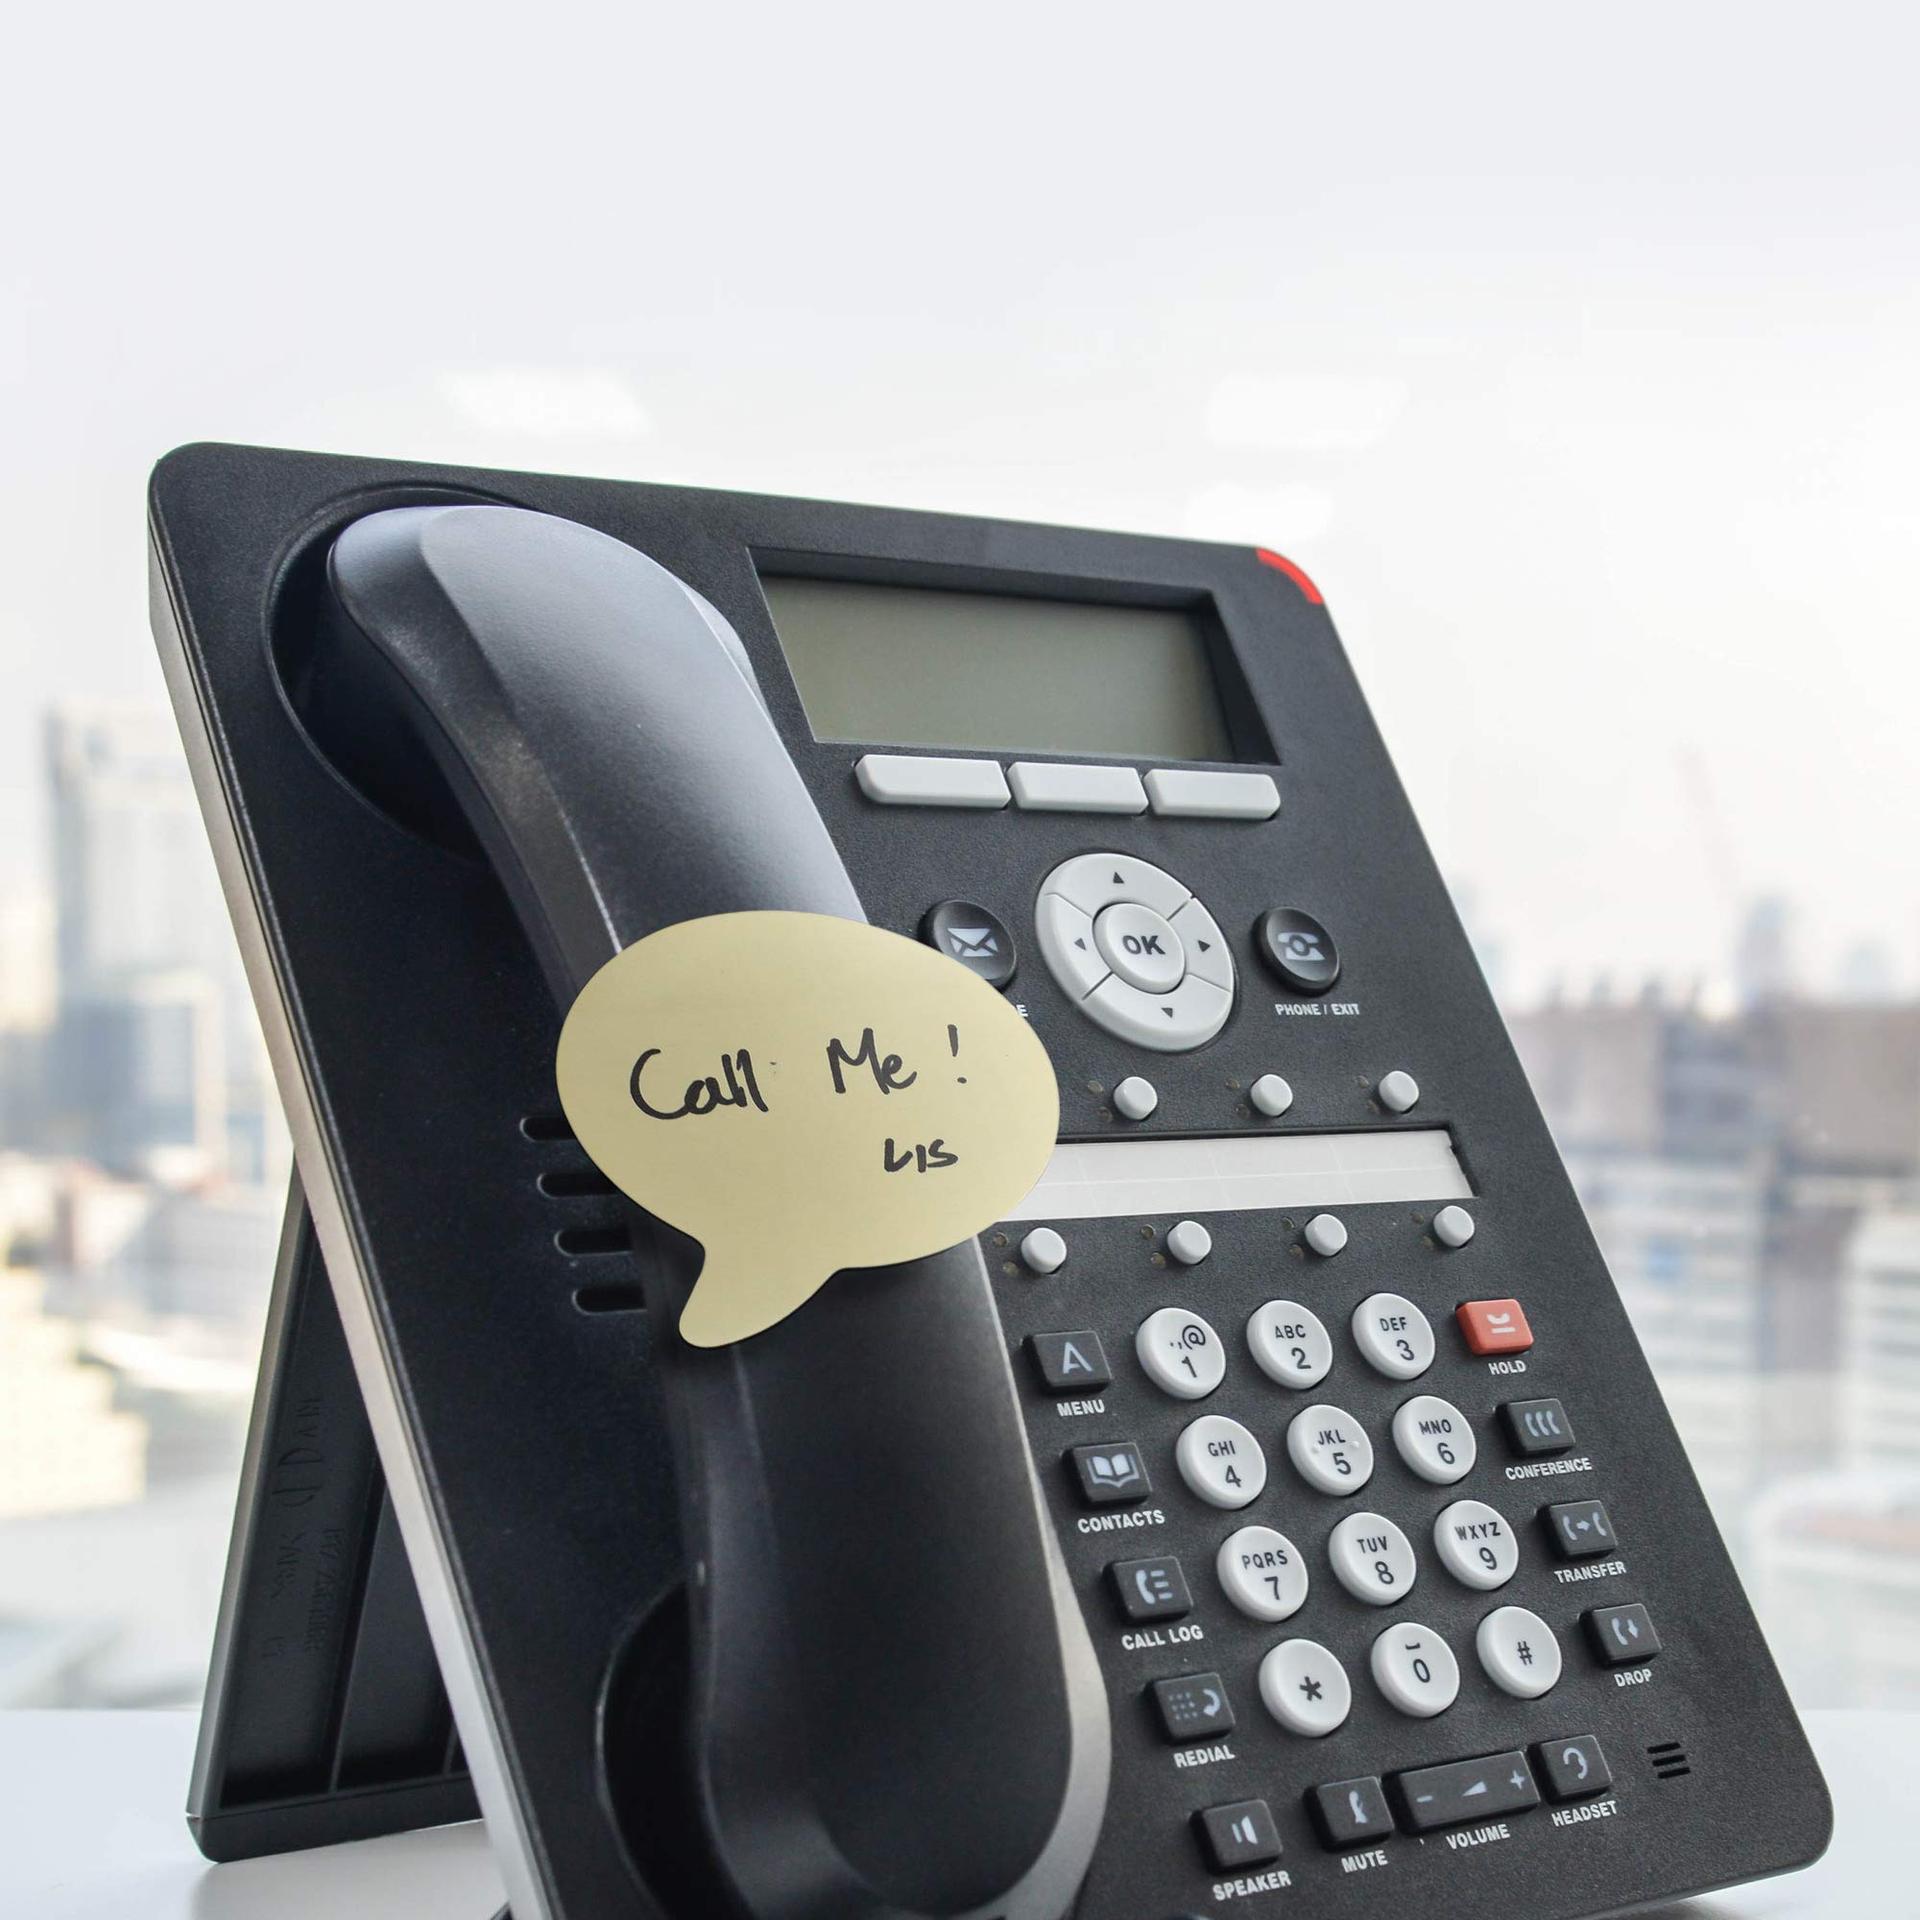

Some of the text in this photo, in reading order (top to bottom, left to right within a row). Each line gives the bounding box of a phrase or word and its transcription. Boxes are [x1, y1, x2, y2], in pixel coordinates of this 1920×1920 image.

[1122, 934, 1166, 956] OK
[1274, 1003, 1322, 1016] PHONE
[1330, 1003, 1360, 1016] EXIT
[629, 1048, 769, 1121] Call
[1275, 1323, 1306, 1339] ABC
[1379, 1316, 1407, 1332] DEF
[1290, 1347, 1312, 1370] 2
[1396, 1339, 1415, 1361] 3
[1181, 1355, 1198, 1378] 1
[1488, 1359, 1527, 1376] HOLD
[1056, 1398, 1106, 1417] MENU
[1318, 1429, 1347, 1446] JKL
[1418, 1418, 1452, 1435] MNO
[1207, 1440, 1236, 1457] GHI
[1437, 1442, 1456, 1465] 6
[1332, 1451, 1352, 1476] 5
[1504, 1457, 1593, 1481] CONFERENCE
[1225, 1464, 1242, 1488] 4
[1077, 1509, 1166, 1534] CONTACTS
[1454, 1521, 1502, 1541] WXYZ
[1356, 1535, 1388, 1554] TUV
[1241, 1549, 1288, 1569] PQRS
[1478, 1546, 1498, 1571] 9
[1374, 1560, 1395, 1585] 8
[1553, 1560, 1627, 1584] TRANSFER
[1264, 1575, 1281, 1601] 7
[1121, 1624, 1204, 1651] CALL LOG
[1412, 1658, 1431, 1684] 0
[1613, 1668, 1653, 1687] DROP
[1173, 1744, 1236, 1769] REDIAL
[1551, 1799, 1618, 1827] HEADSET
[1445, 1823, 1511, 1850] VOLUME
[1341, 1849, 1389, 1873] MUTE
[1212, 1870, 1292, 1901] SPEAKER
